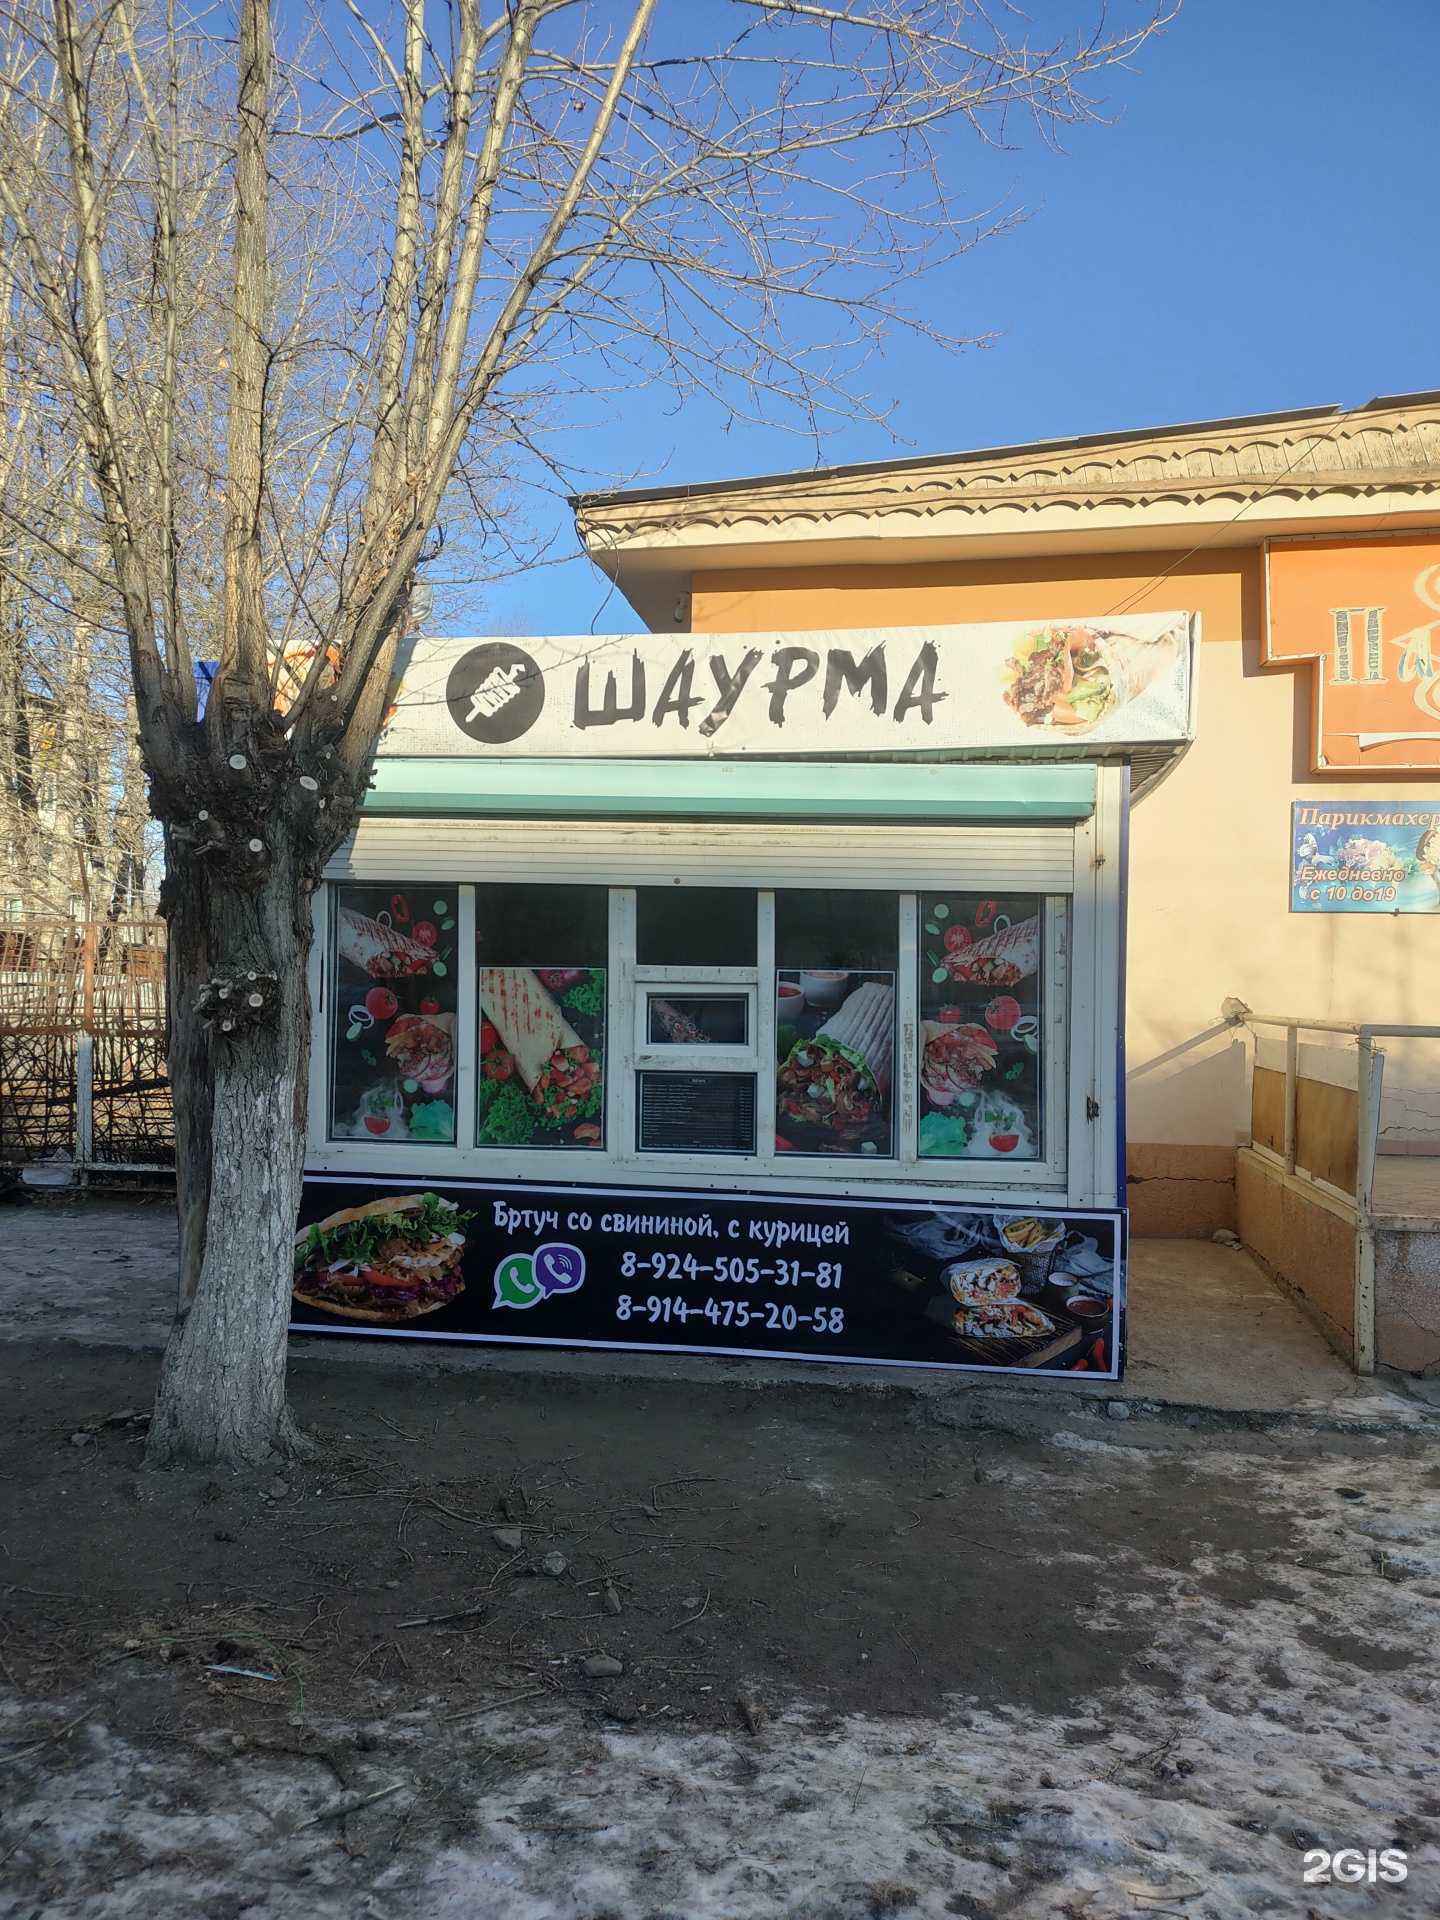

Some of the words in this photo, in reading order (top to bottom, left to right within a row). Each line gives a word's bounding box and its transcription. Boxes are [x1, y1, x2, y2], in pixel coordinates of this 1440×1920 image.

[572, 640, 950, 737] ШАУРМА
[1301, 866, 1405, 881] Ежедневно
[1310, 888, 1321, 901] с
[1327, 886, 1347, 901] 10
[493, 1201, 559, 1236] Бртуч
[567, 1212, 593, 1231] со
[600, 1213, 719, 1239] свининой,
[728, 1219, 740, 1238] с
[749, 1220, 850, 1249] курицей
[620, 1250, 843, 1289] 8-924-505-31-81
[615, 1294, 845, 1334] 8-914-475-20-58
